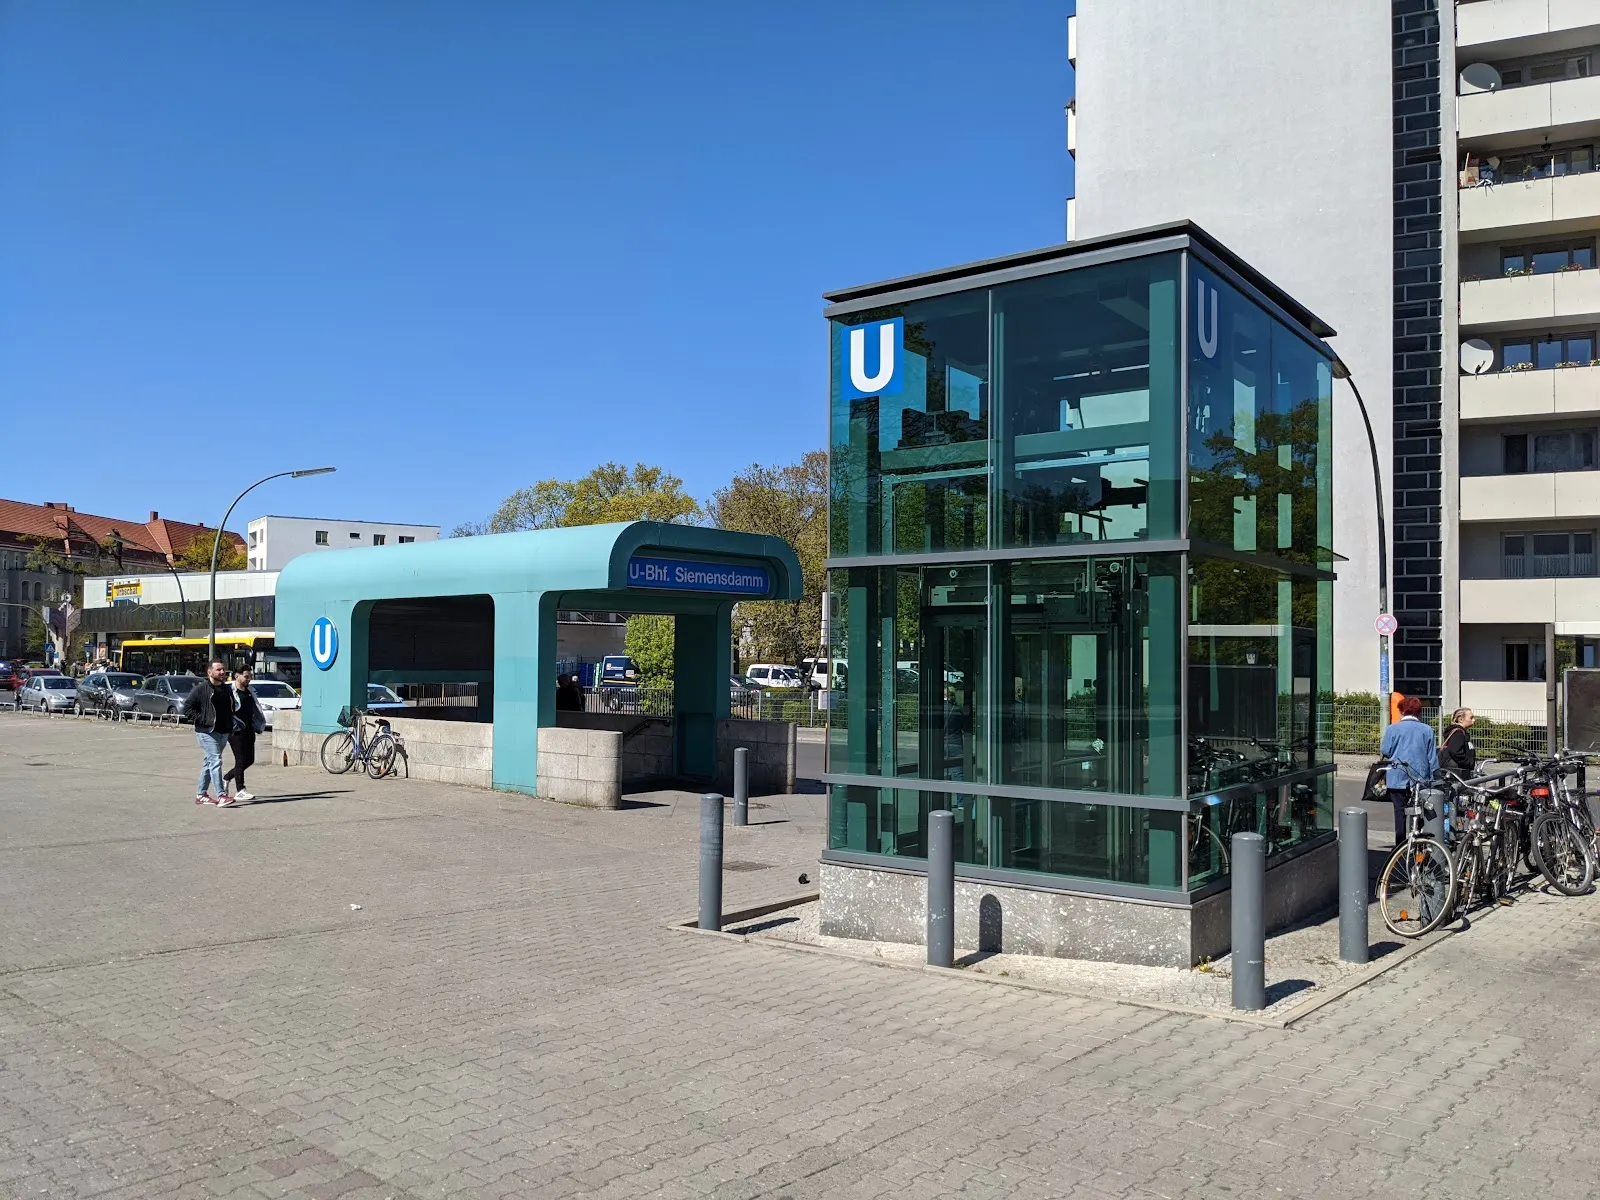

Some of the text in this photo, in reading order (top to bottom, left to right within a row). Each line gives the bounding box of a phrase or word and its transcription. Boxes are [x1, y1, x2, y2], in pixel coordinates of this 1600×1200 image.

[1197, 278, 1218, 359] U
[850, 323, 895, 393] U
[629, 563, 763, 588] U-Bhf. Siemensdamm
[314, 624, 332, 663] U
